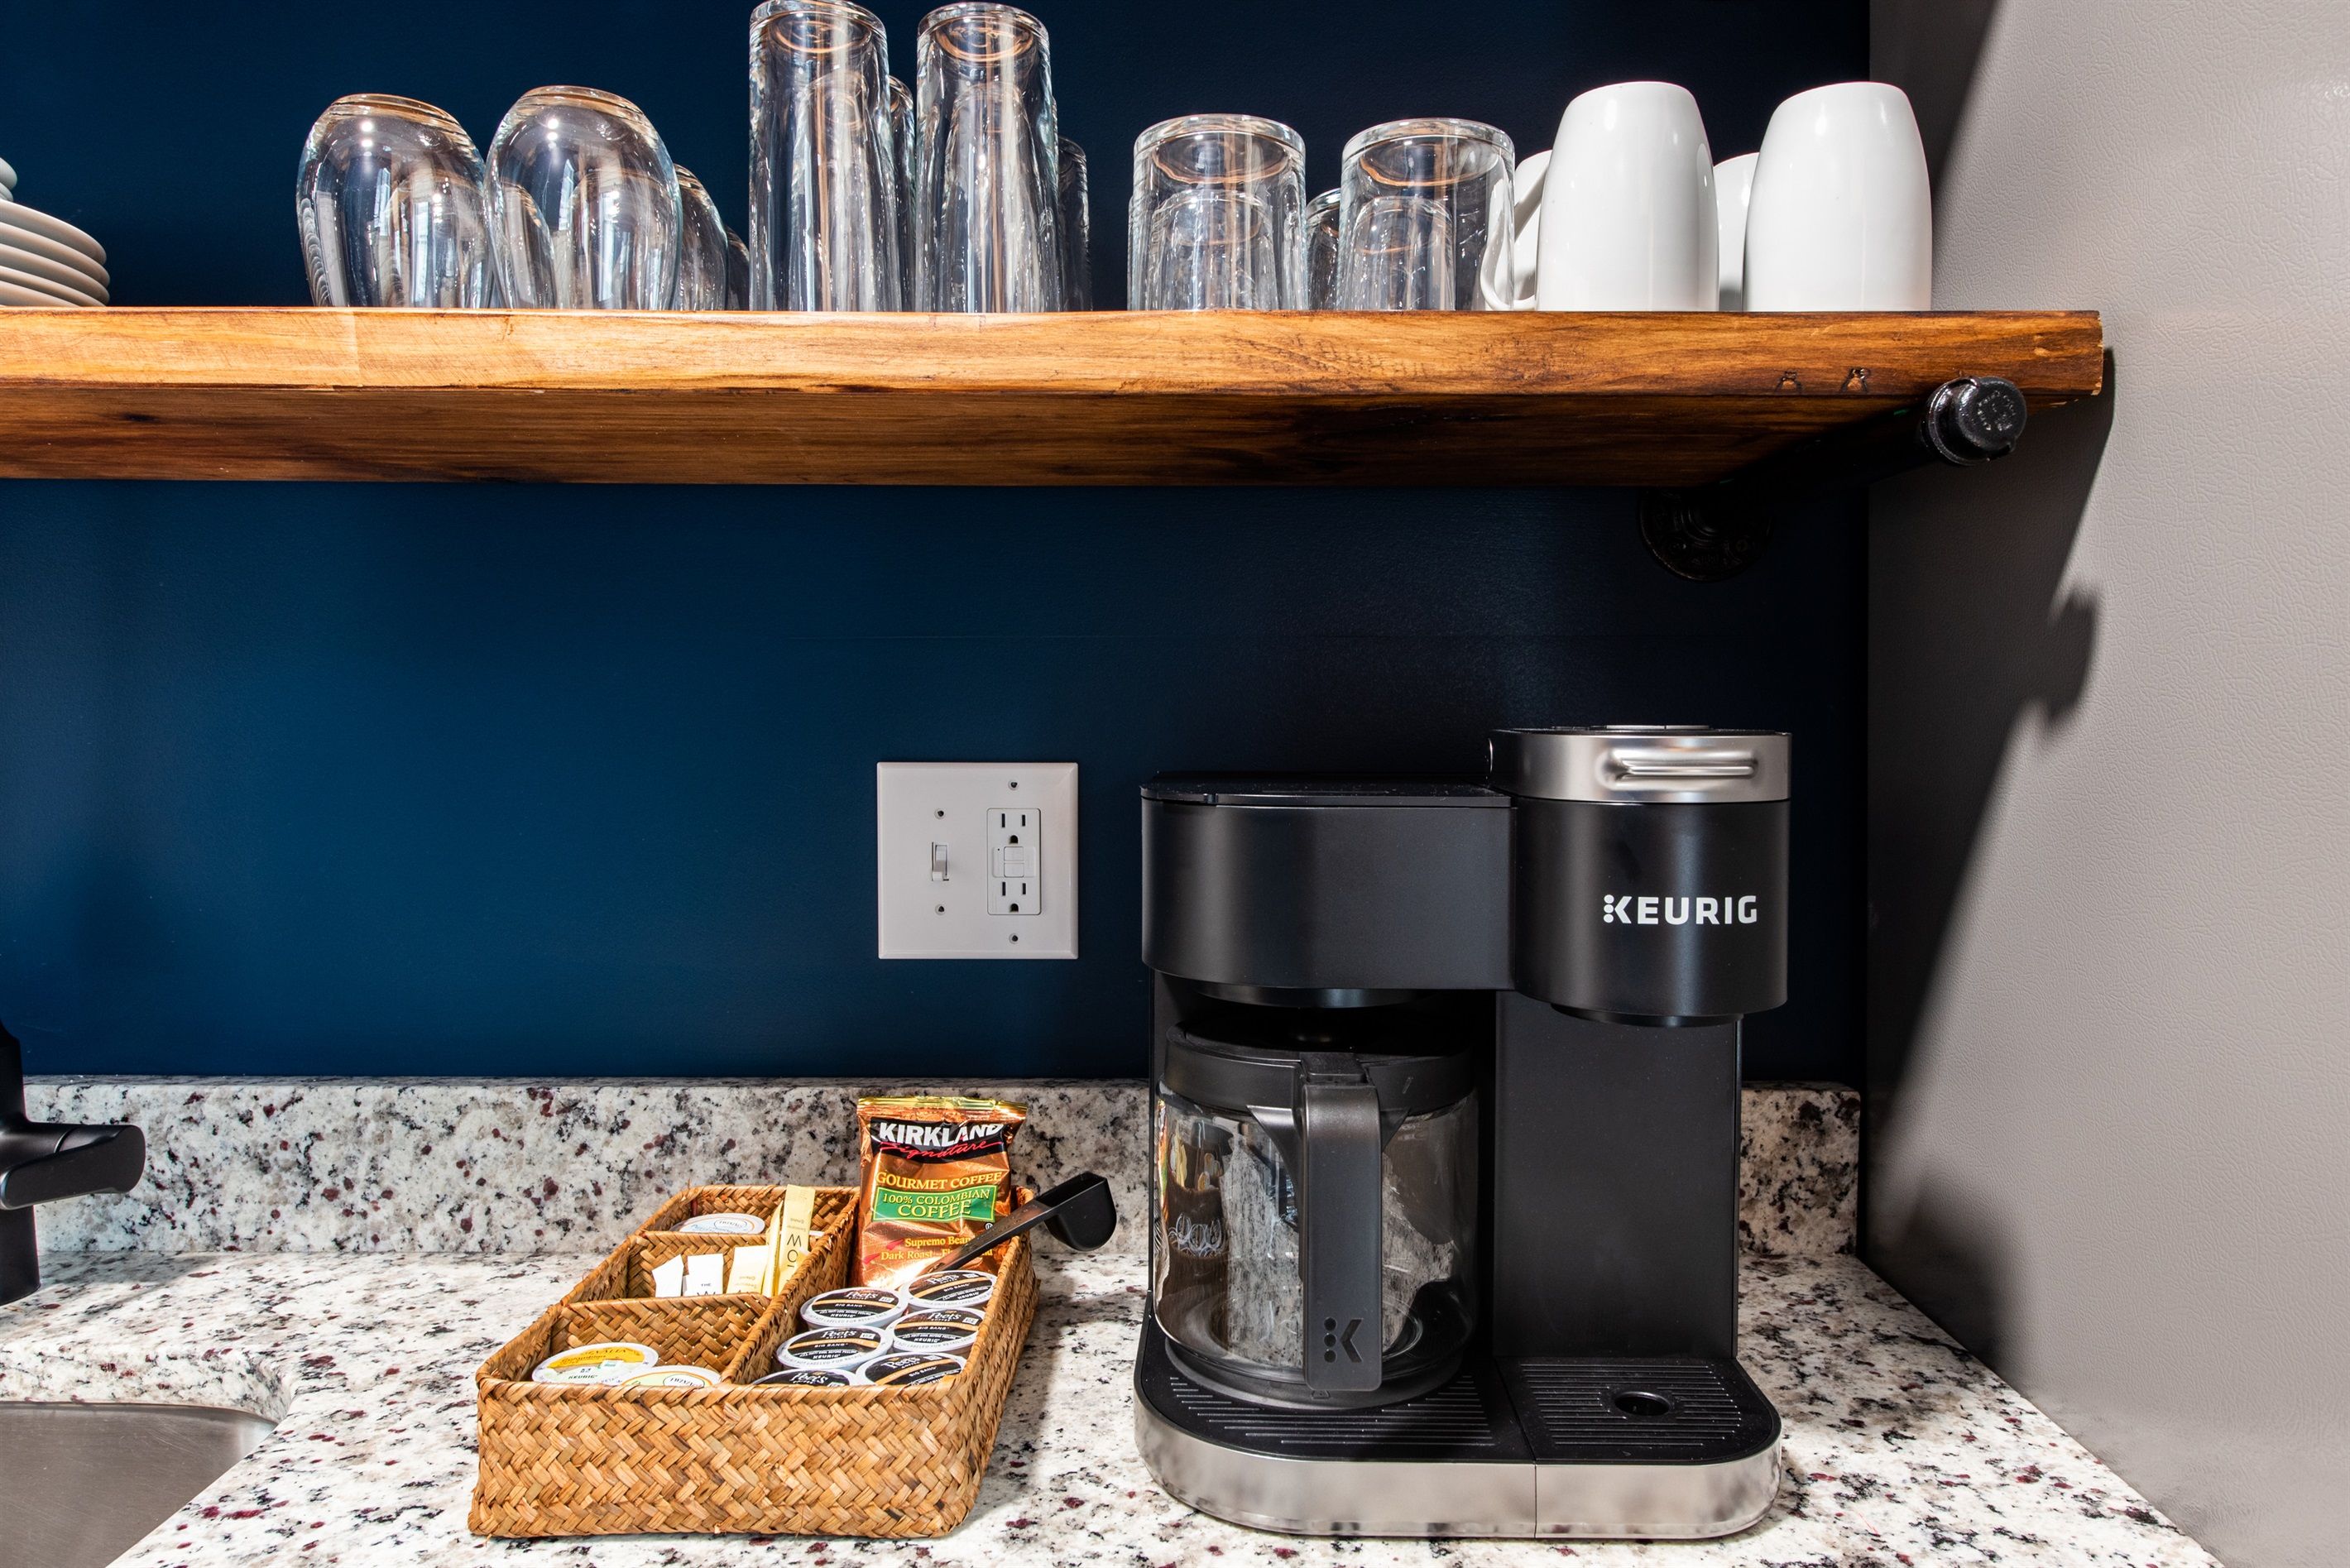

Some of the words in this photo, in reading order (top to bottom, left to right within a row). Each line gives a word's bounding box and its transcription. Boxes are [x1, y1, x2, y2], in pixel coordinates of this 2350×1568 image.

[1604, 894, 1758, 925] KEURIG
[879, 1121, 1005, 1147] KIRKLAND
[880, 1140, 1004, 1159] Signature
[875, 1171, 947, 1190] GOURMET
[950, 1171, 1003, 1189] COFFEE
[883, 1192, 913, 1204] 100%
[916, 1189, 991, 1205] COLOMBIAN
[898, 1200, 972, 1219] COFFEE
[904, 1238, 945, 1251] Supremo
[881, 1251, 904, 1260] Dark
[908, 1250, 933, 1259] Roast
